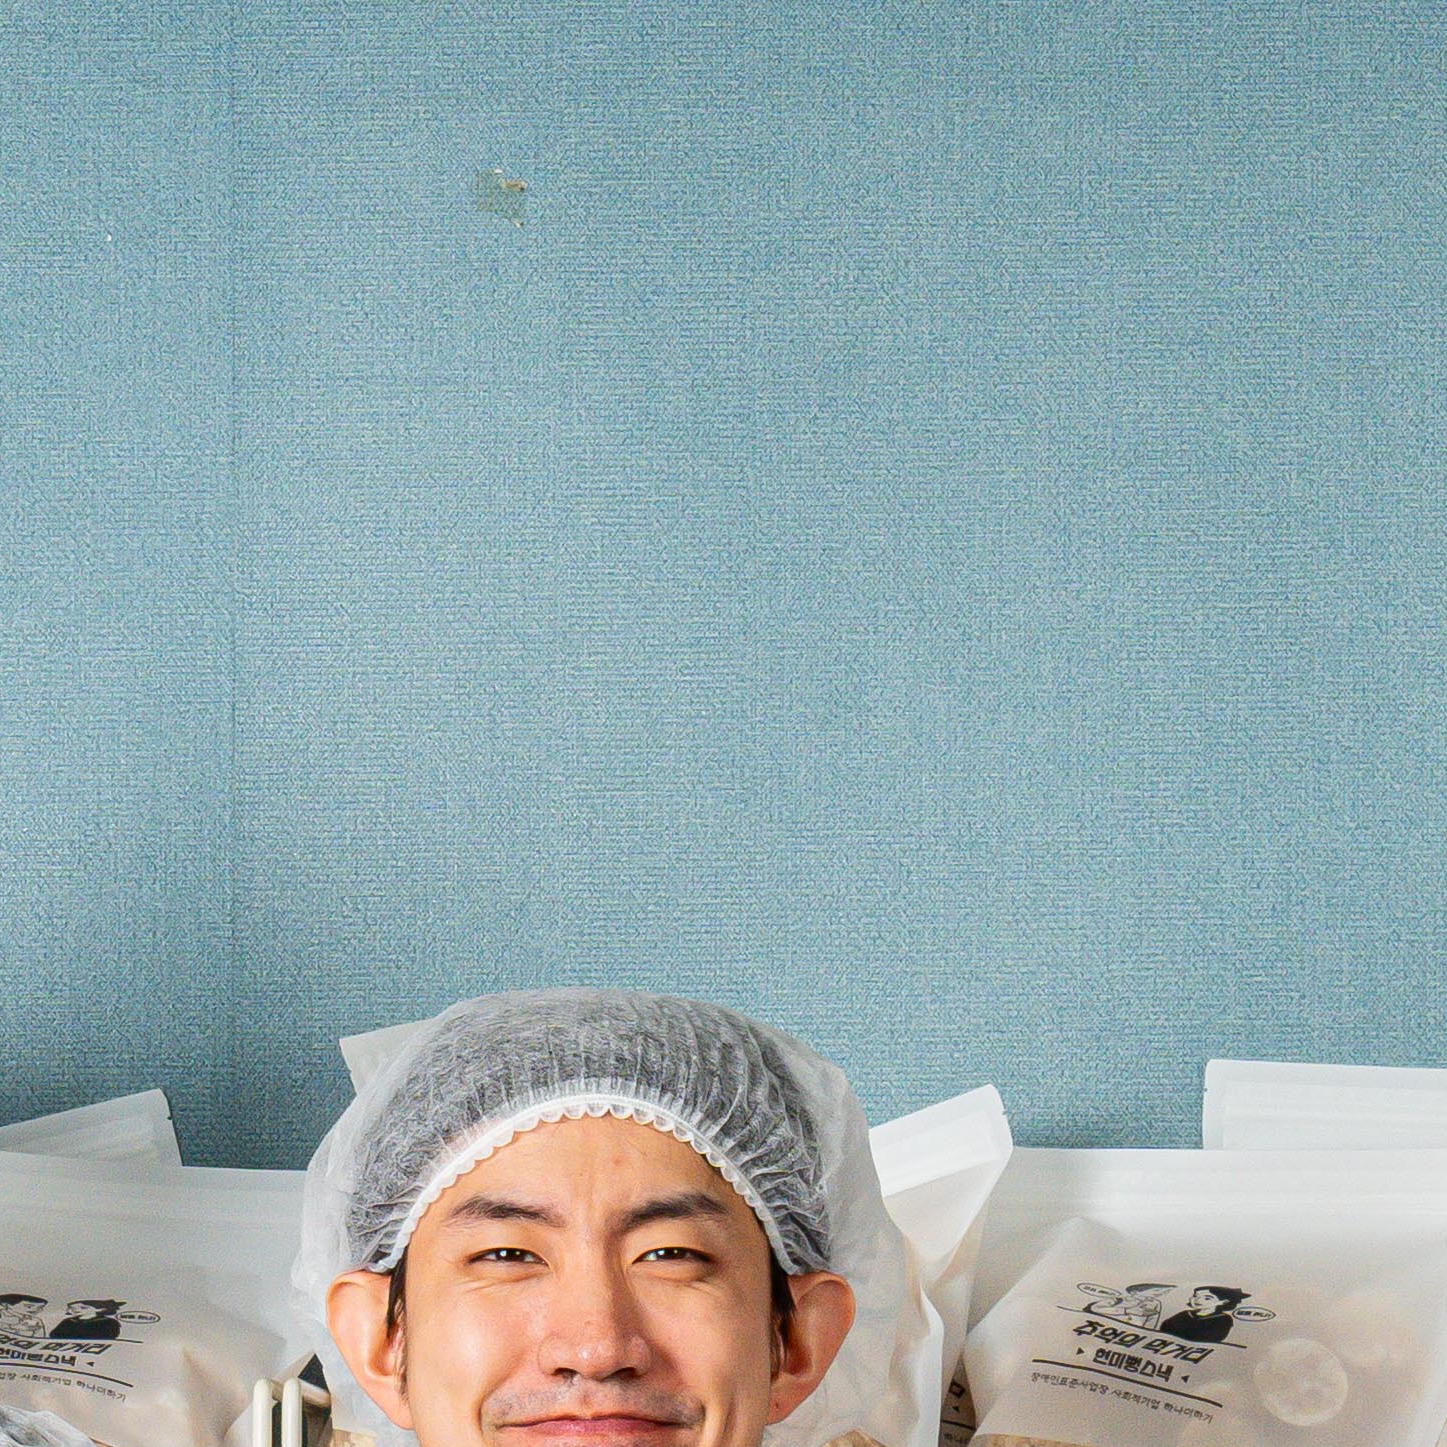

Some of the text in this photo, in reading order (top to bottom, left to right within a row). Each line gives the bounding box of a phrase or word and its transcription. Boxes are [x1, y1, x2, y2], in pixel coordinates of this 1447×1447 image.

[1072, 1319, 1215, 1365] 추억의 먹거리
[1092, 1347, 1175, 1383] 현미뻥스낵
[1030, 1371, 1110, 1396] 장애인표준사업장
[1110, 1387, 1161, 1410] 사회적기업
